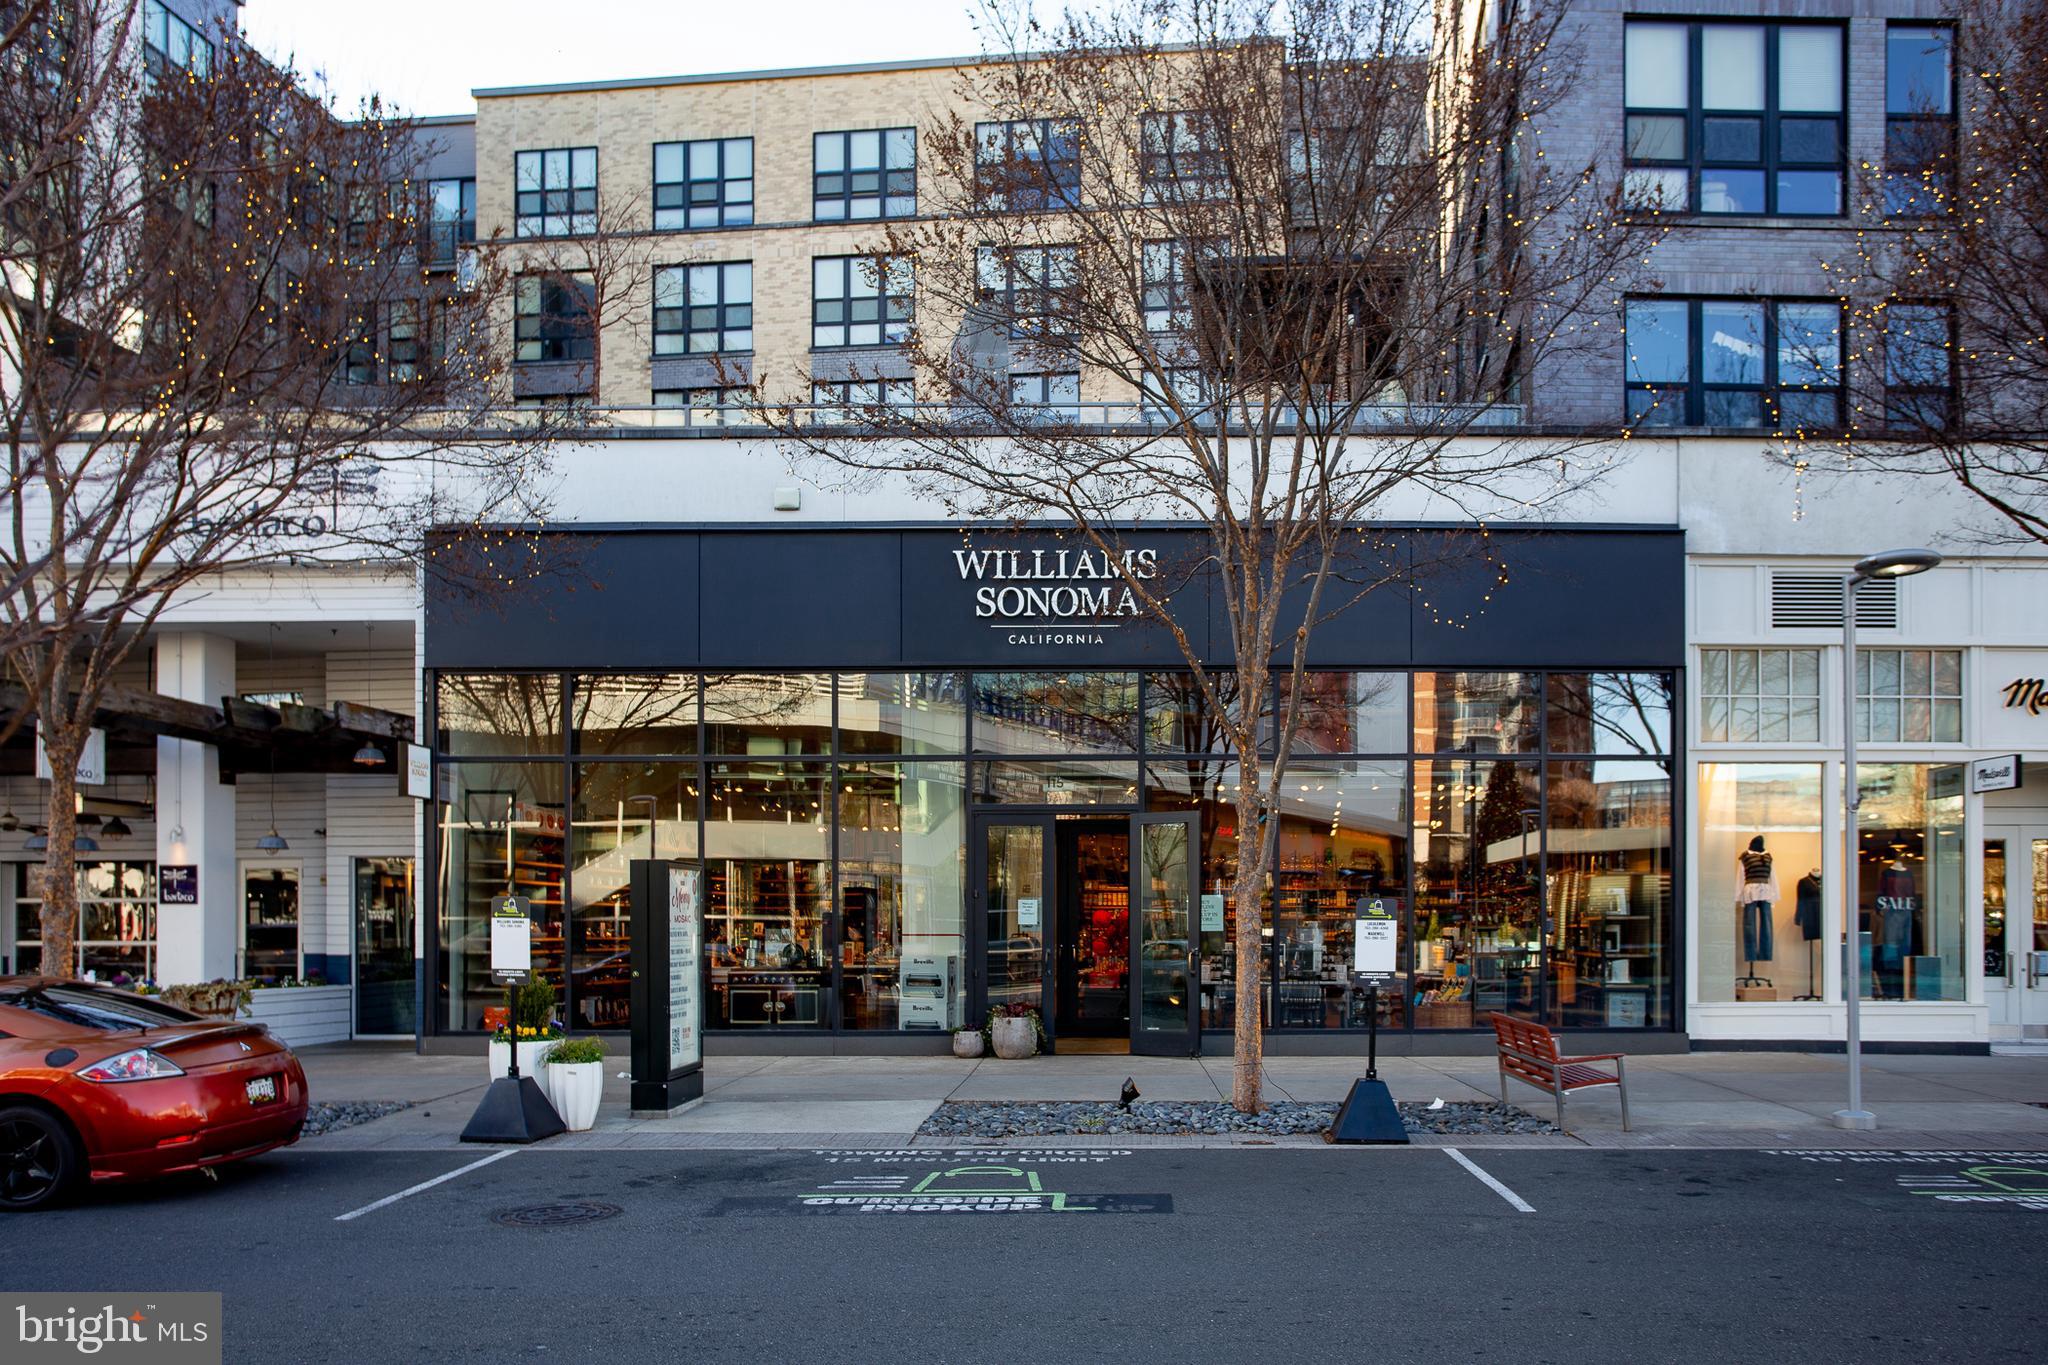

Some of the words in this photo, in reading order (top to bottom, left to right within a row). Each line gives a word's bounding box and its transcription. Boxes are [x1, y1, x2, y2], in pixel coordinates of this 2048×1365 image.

[952, 549, 1158, 579] WILLIAMS
[975, 587, 1142, 617] SONOMA
[1008, 634, 1104, 645] CALIFORNIA
[1877, 896, 1916, 910] SALE
[802, 1196, 1043, 1205] CURBSIDE
[859, 1203, 1043, 1212] PICKUP
